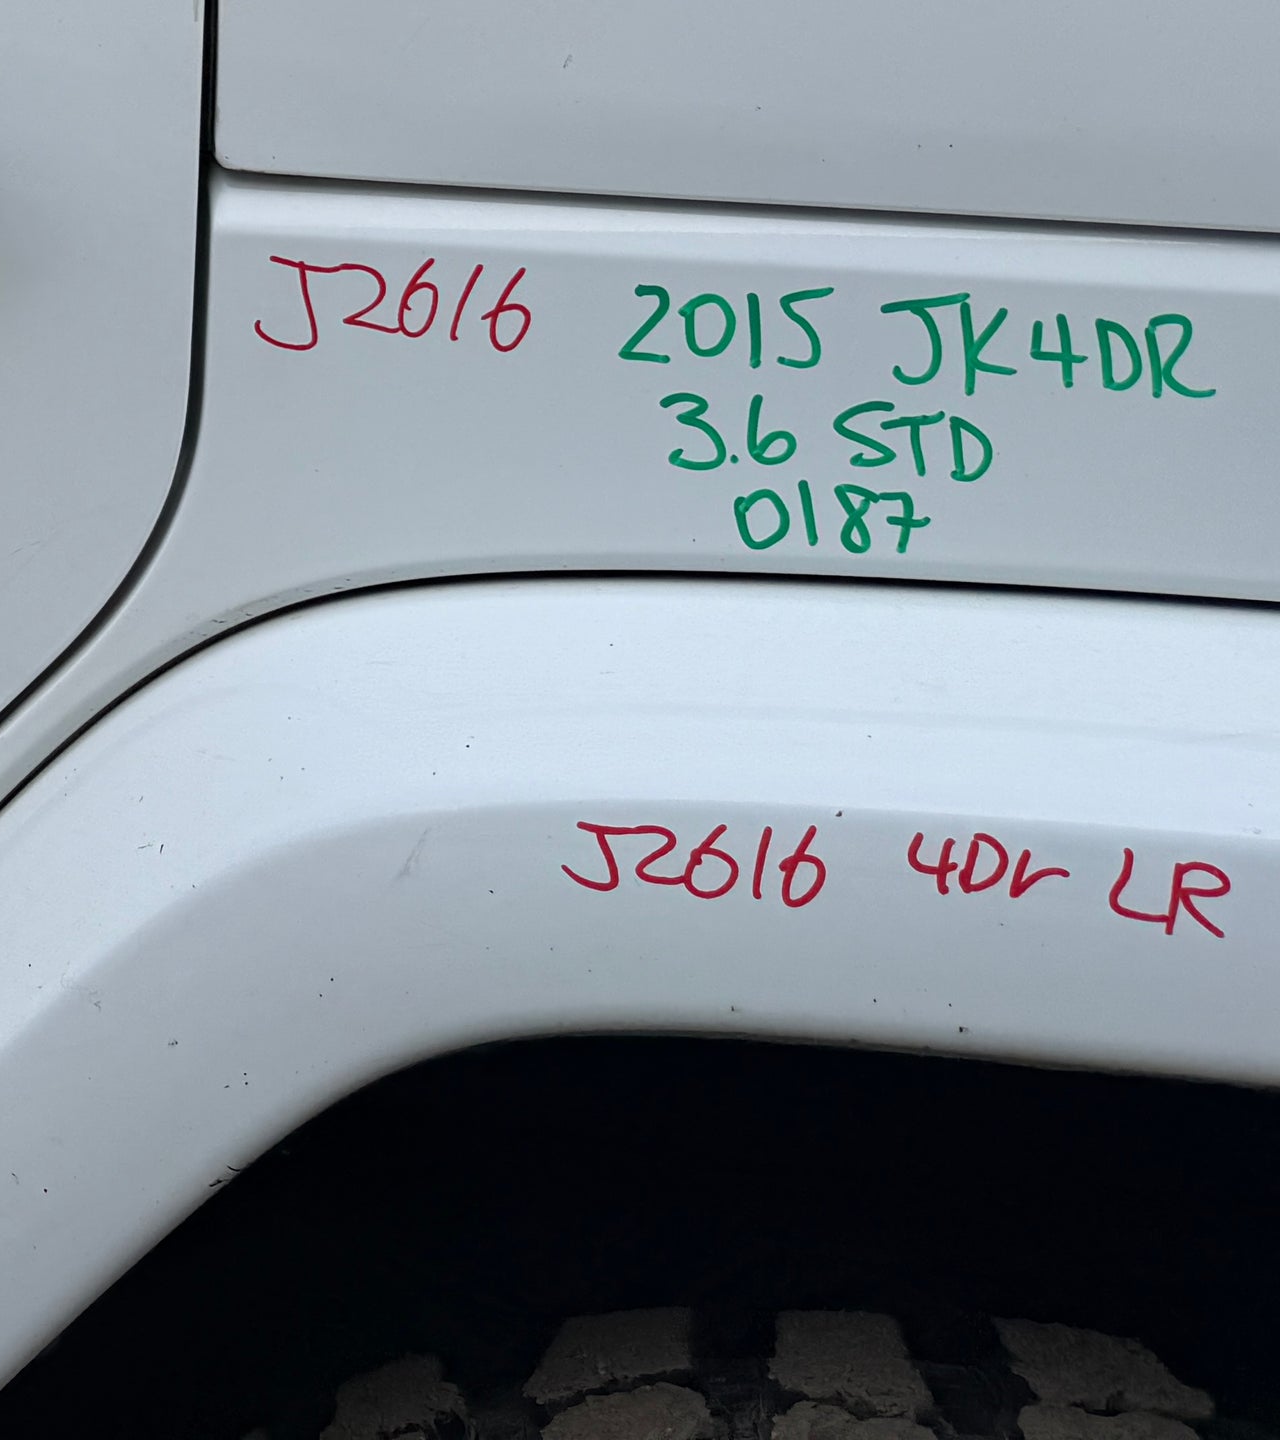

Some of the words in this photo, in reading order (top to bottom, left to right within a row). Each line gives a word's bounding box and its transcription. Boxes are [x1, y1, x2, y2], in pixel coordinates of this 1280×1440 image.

[254, 255, 532, 353] J2616
[618, 284, 834, 370] 2015
[659, 392, 798, 472] 3.6
[832, 399, 995, 483] STD
[733, 479, 932, 555] 0187
[562, 821, 827, 909] J2616
[1109, 848, 1232, 938] LR
